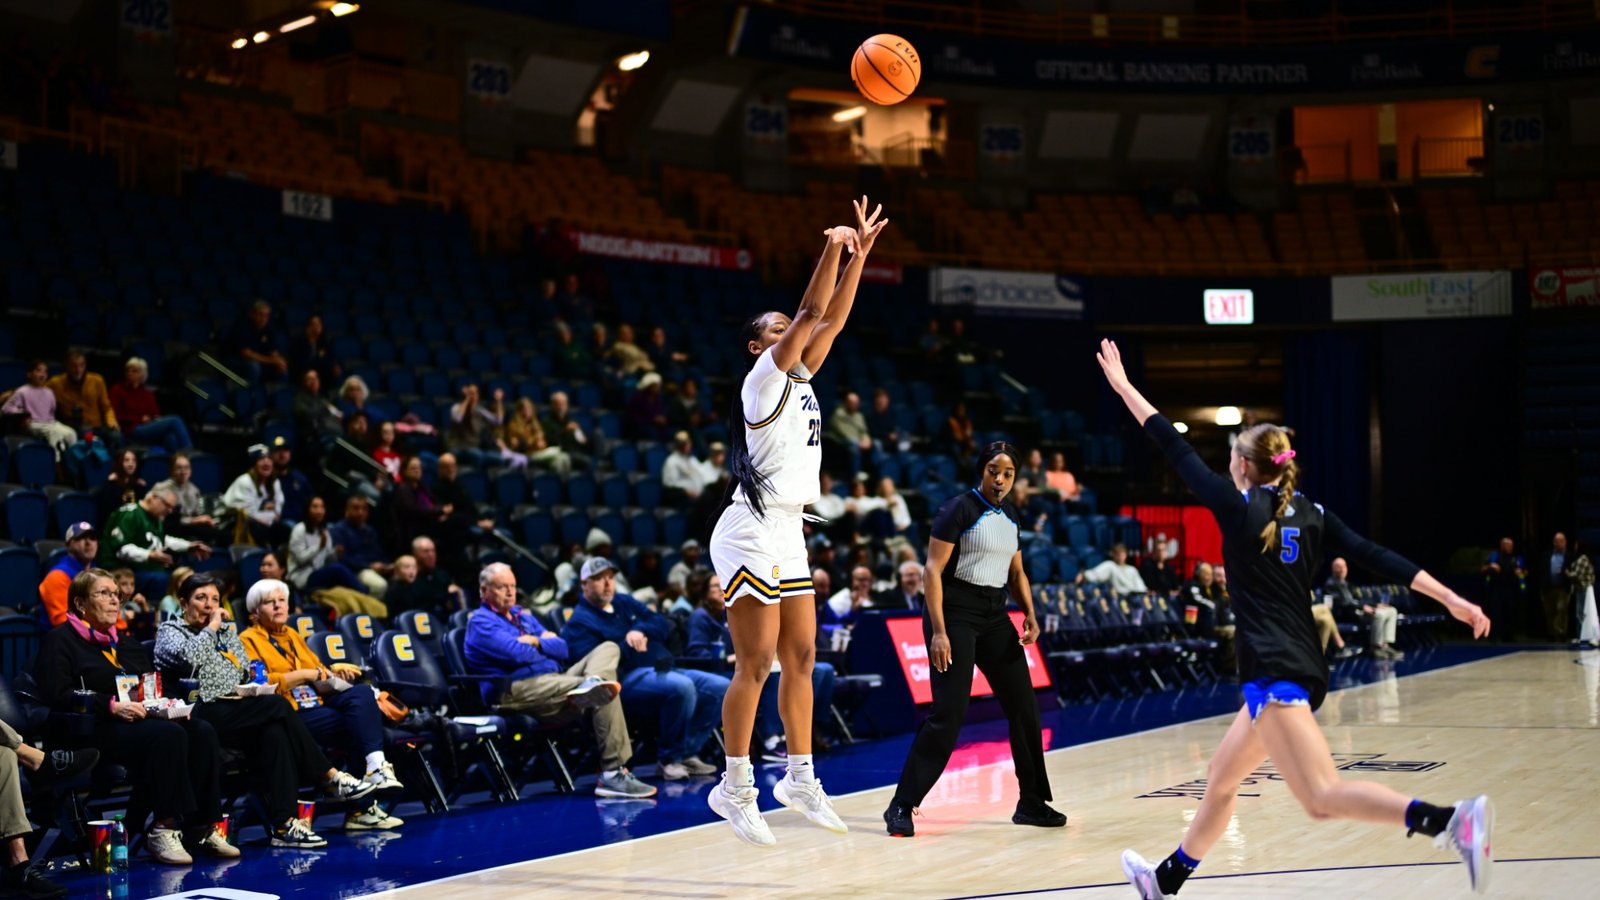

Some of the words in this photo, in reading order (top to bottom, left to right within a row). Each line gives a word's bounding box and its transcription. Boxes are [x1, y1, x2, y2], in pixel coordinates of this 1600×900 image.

[125, 0, 168, 31] 202
[471, 62, 510, 95] 203
[1035, 58, 1119, 83] OFFICIAL
[1123, 61, 1210, 85] BANKING
[1215, 62, 1309, 85] PARTNER
[748, 106, 784, 135] 204
[1499, 117, 1542, 143] 206
[291, 193, 324, 218] 102
[1367, 276, 1474, 298] SouthEast
[1209, 294, 1246, 320] EXIT
[1280, 526, 1301, 565] 5
